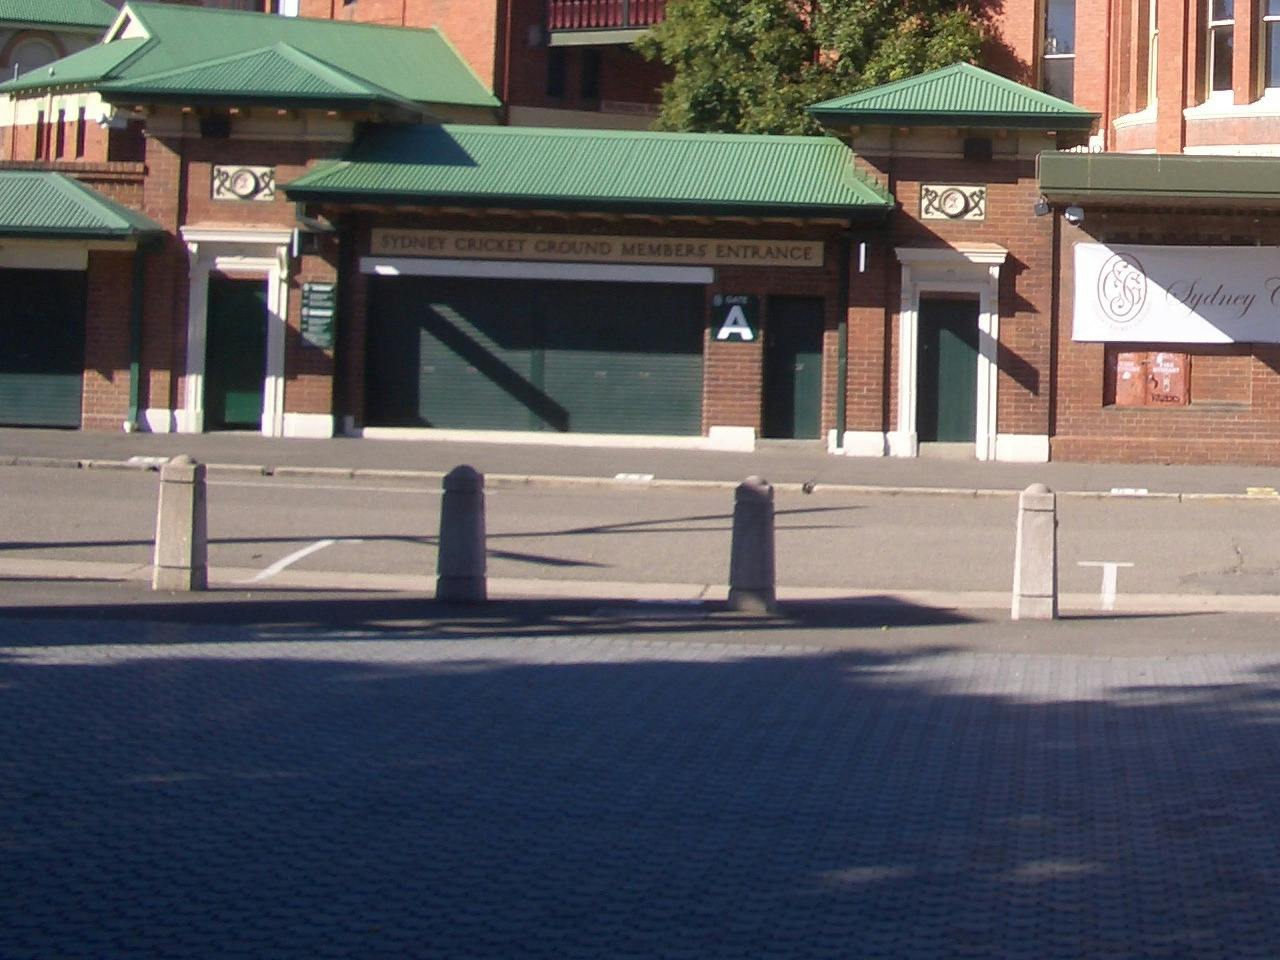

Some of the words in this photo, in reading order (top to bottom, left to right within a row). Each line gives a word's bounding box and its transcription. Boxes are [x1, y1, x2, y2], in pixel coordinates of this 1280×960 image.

[380, 234, 448, 250] SYDNEY
[454, 237, 527, 253] CRICKET
[533, 239, 613, 256] GROUND
[620, 242, 706, 258] MEMBERS
[716, 245, 813, 261] ENTRANCE
[1165, 277, 1258, 319] Sydney
[717, 305, 754, 340] A
